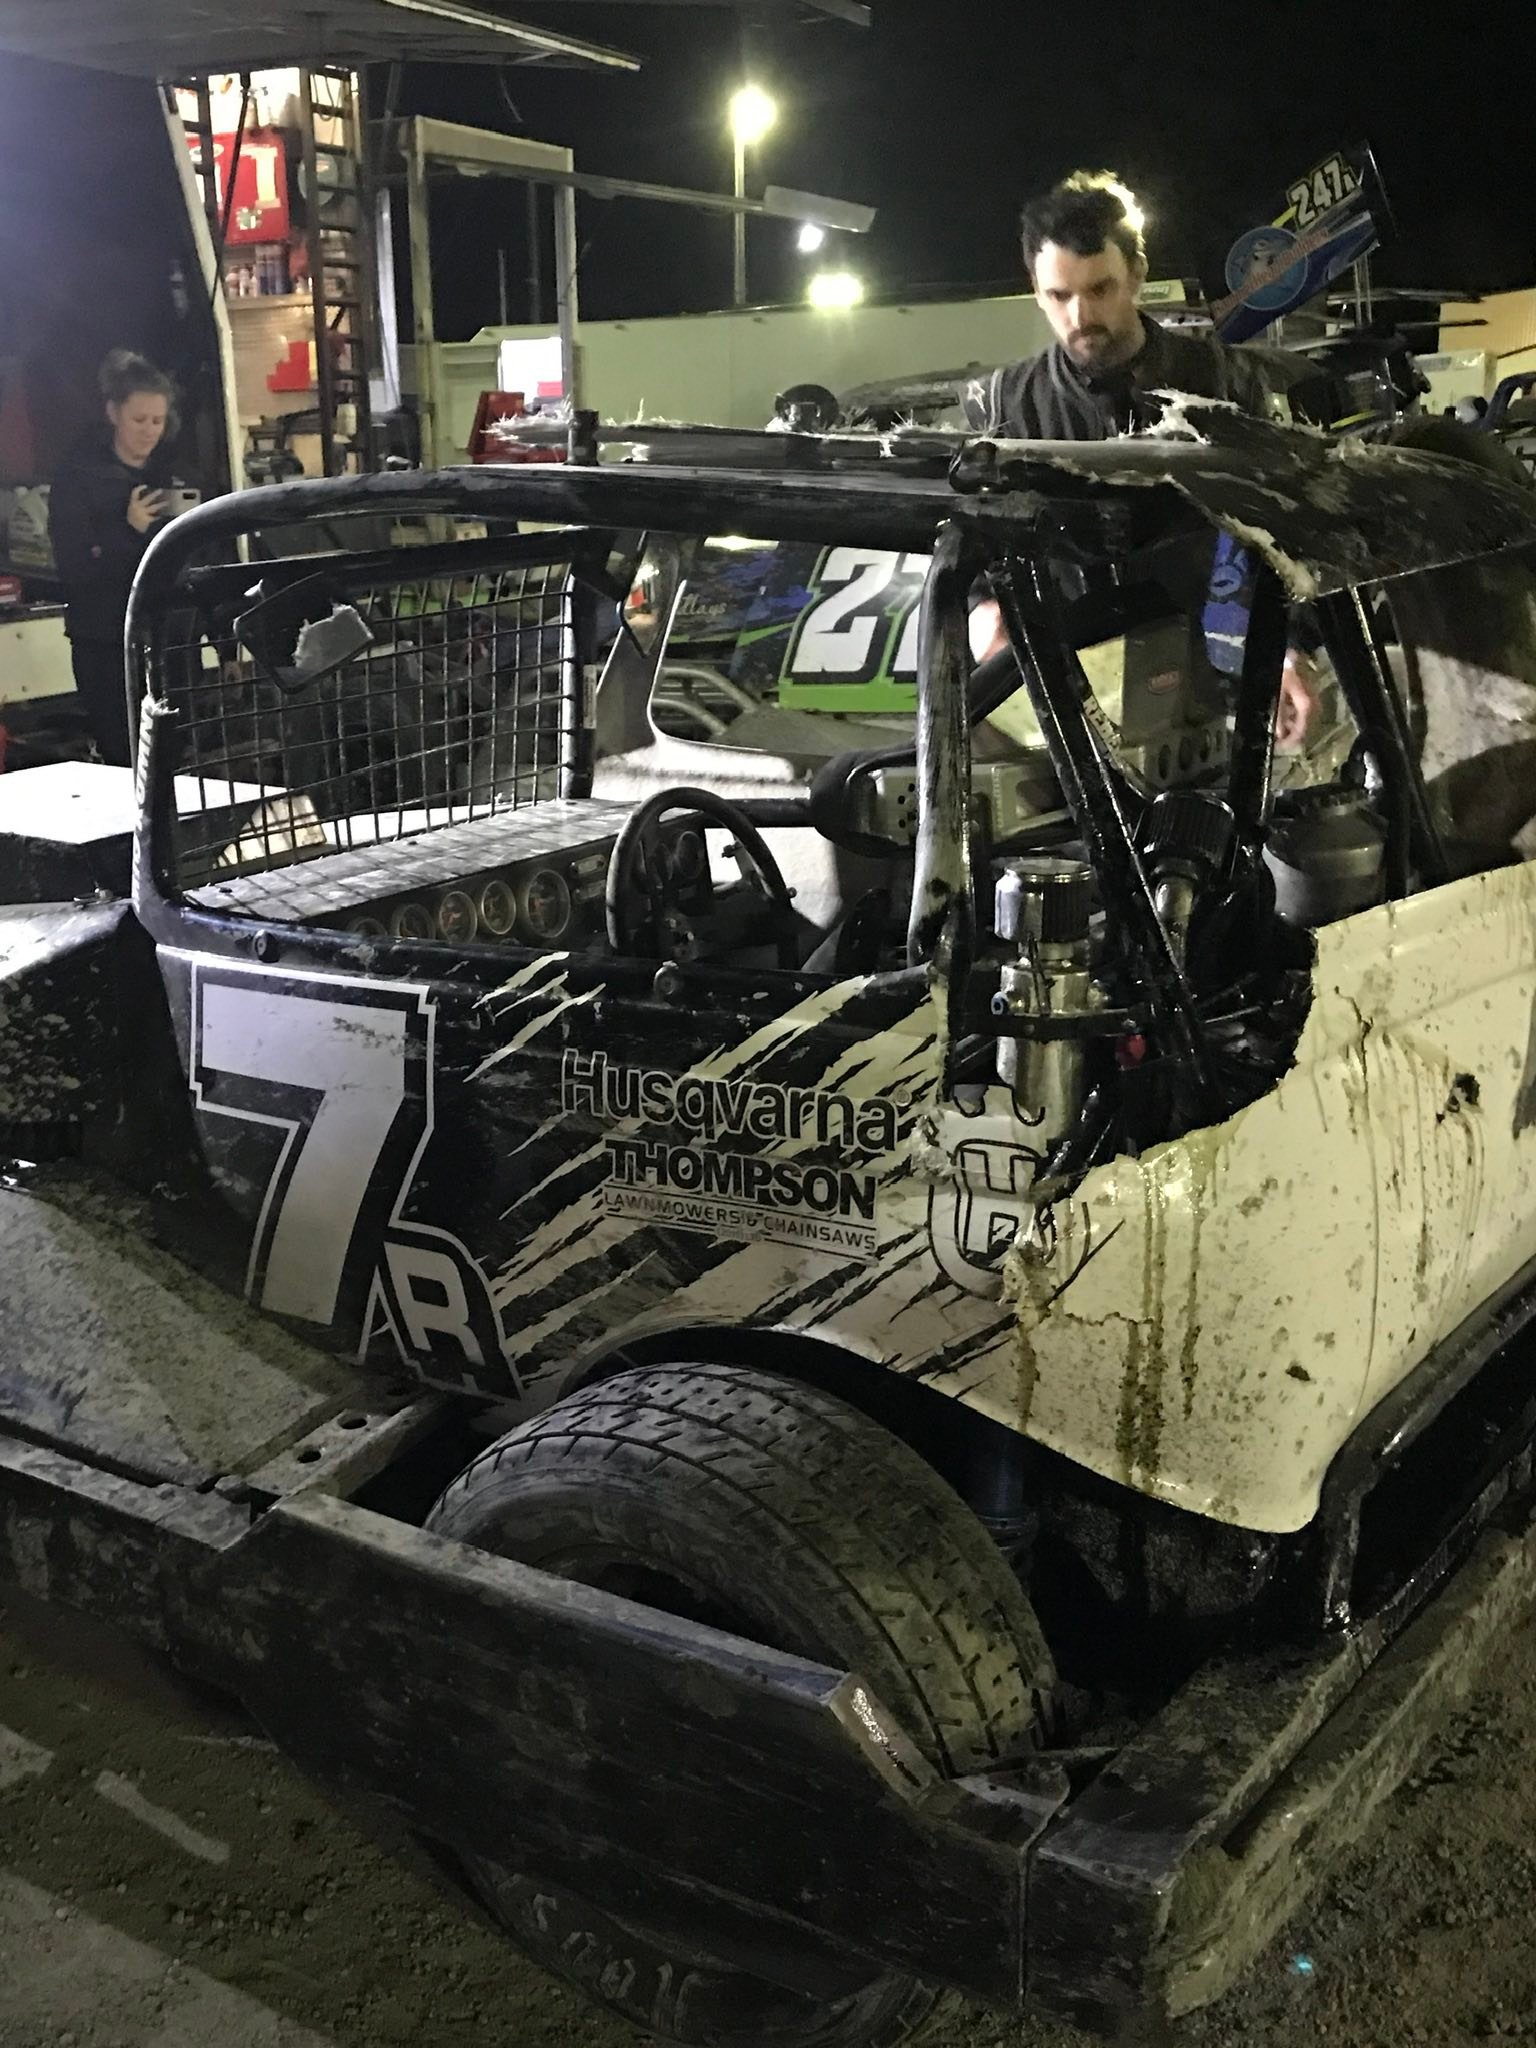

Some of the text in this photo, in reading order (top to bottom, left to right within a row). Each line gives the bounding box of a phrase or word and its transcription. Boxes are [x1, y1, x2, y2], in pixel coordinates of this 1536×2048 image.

[561, 1048, 899, 1152] Husqvarna
[603, 1137, 877, 1222] THOMPSON
[604, 1191, 741, 1226] LAWNMOWERS
[763, 1215, 876, 1251] CHAINSAWS
